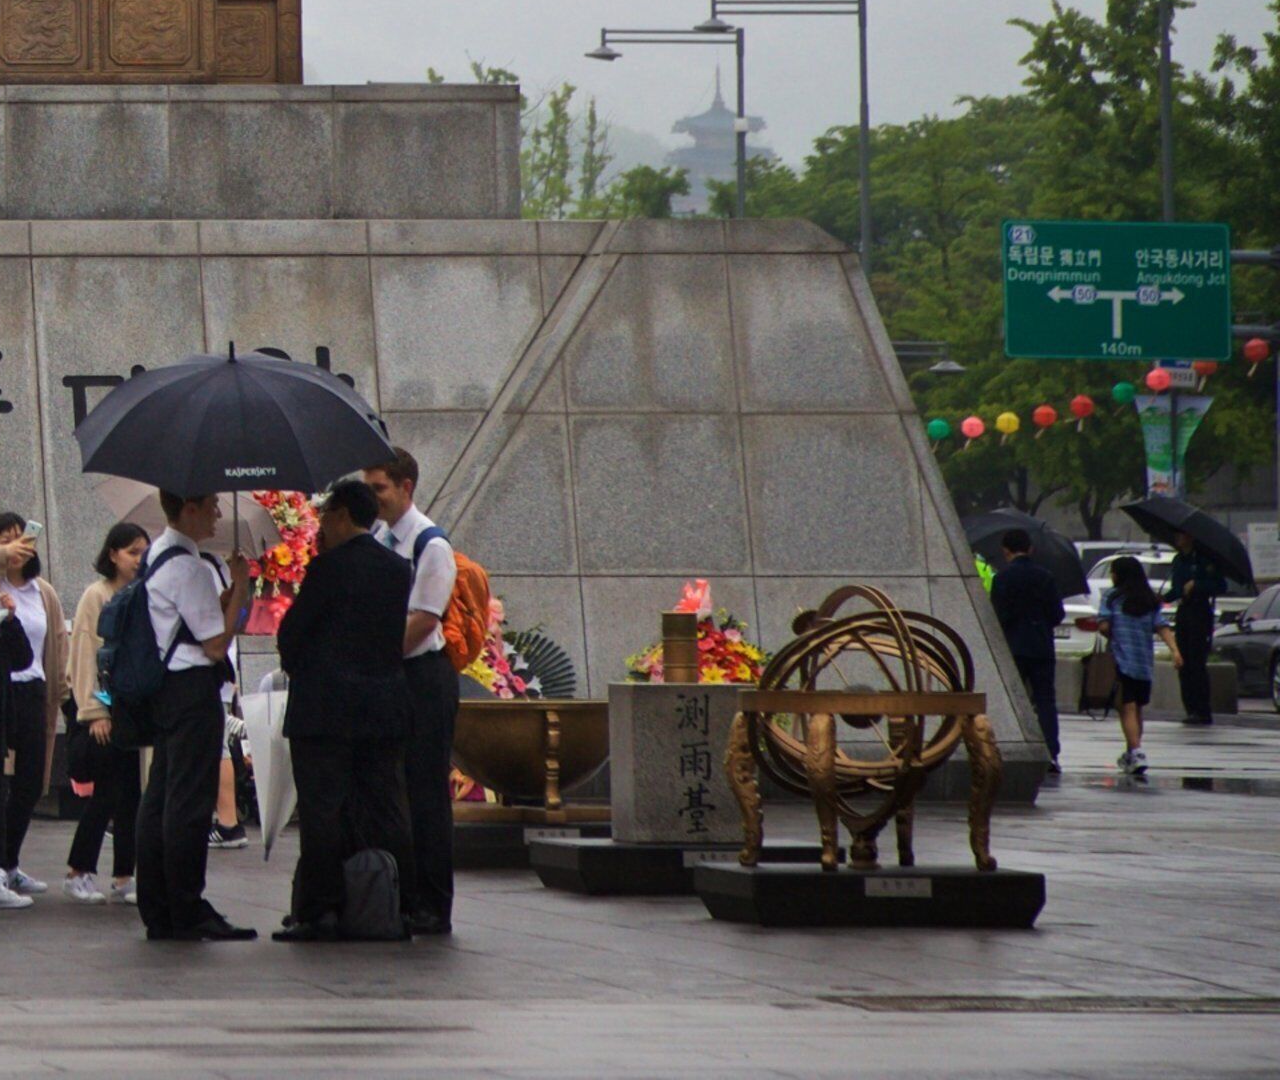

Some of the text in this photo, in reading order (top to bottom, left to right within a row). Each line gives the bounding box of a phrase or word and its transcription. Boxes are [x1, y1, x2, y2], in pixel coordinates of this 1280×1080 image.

[1014, 227, 1031, 242] 21
[1008, 245, 1055, 266] 독립문
[1135, 248, 1224, 269] 안국동사거리
[1007, 267, 1101, 284] Dongnimmun
[1136, 271, 1204, 288] Angukdong
[1076, 289, 1094, 302] 50
[1141, 289, 1157, 302] 50
[1101, 342, 1142, 356] 140m
